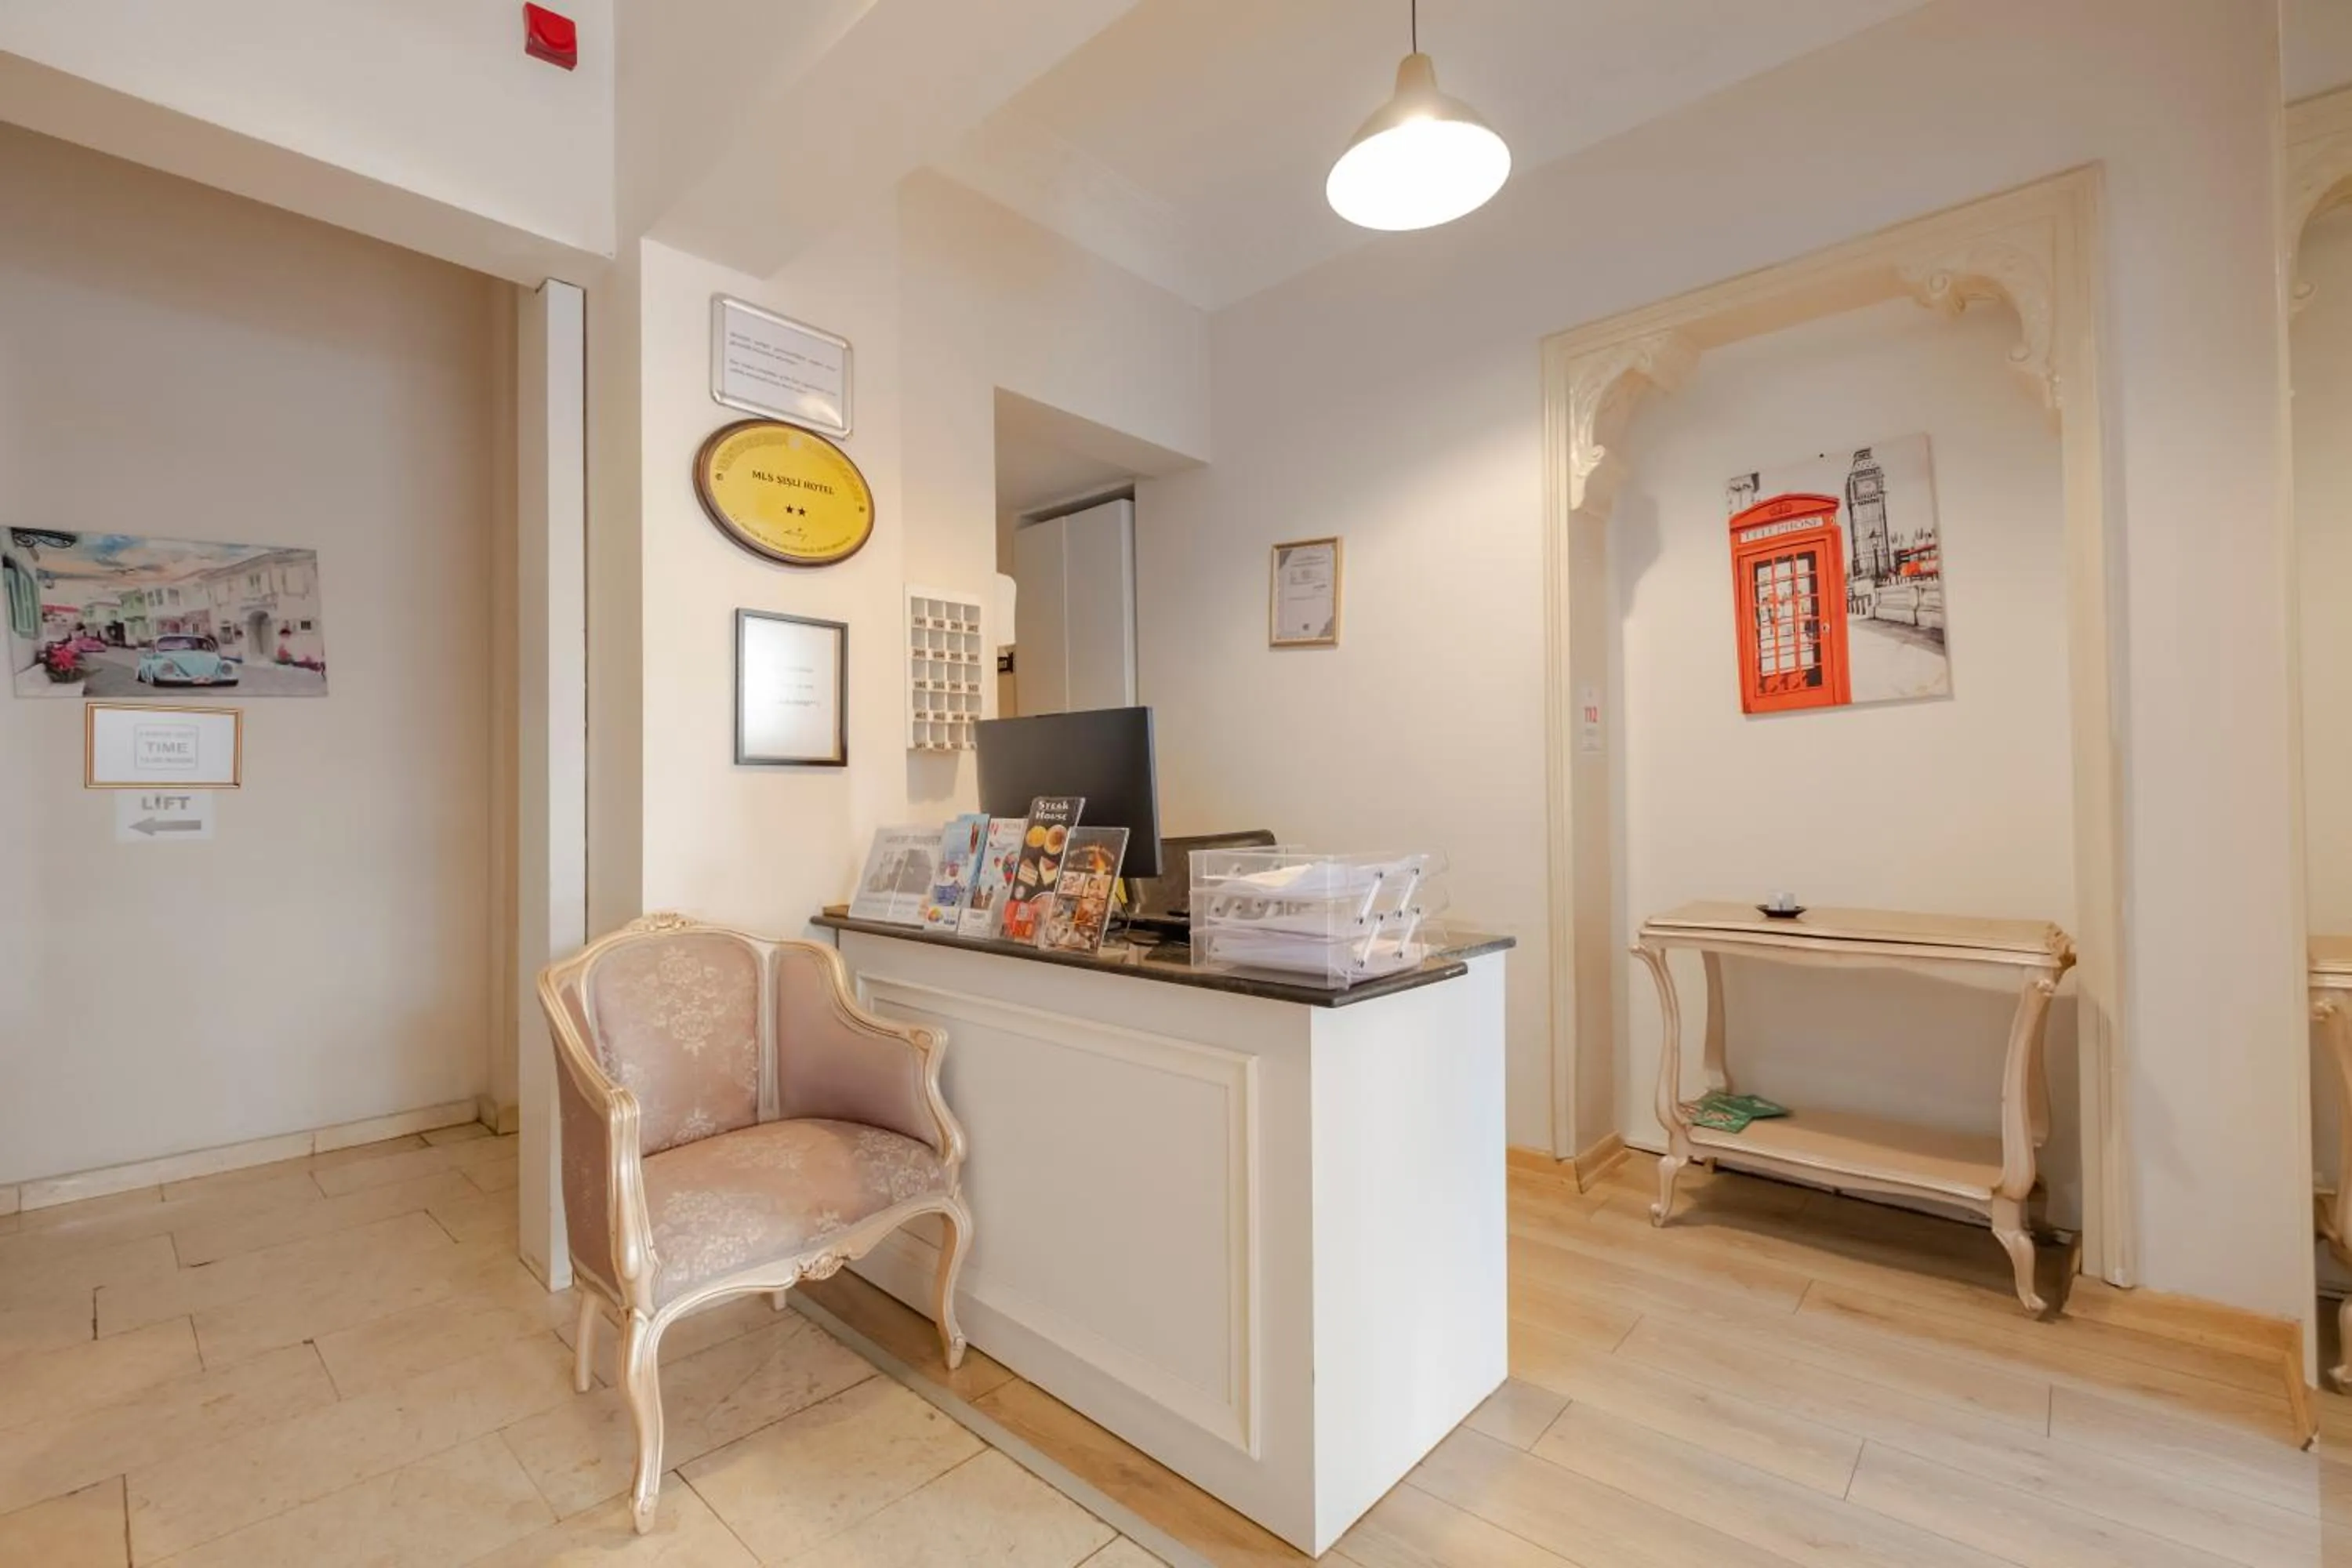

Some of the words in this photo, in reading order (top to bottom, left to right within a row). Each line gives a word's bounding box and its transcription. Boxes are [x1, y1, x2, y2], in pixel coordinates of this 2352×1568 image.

[752, 470, 774, 482] MLS
[803, 480, 834, 495] HOTEL
[145, 741, 189, 754] TIME
[141, 793, 191, 811] LIFT
